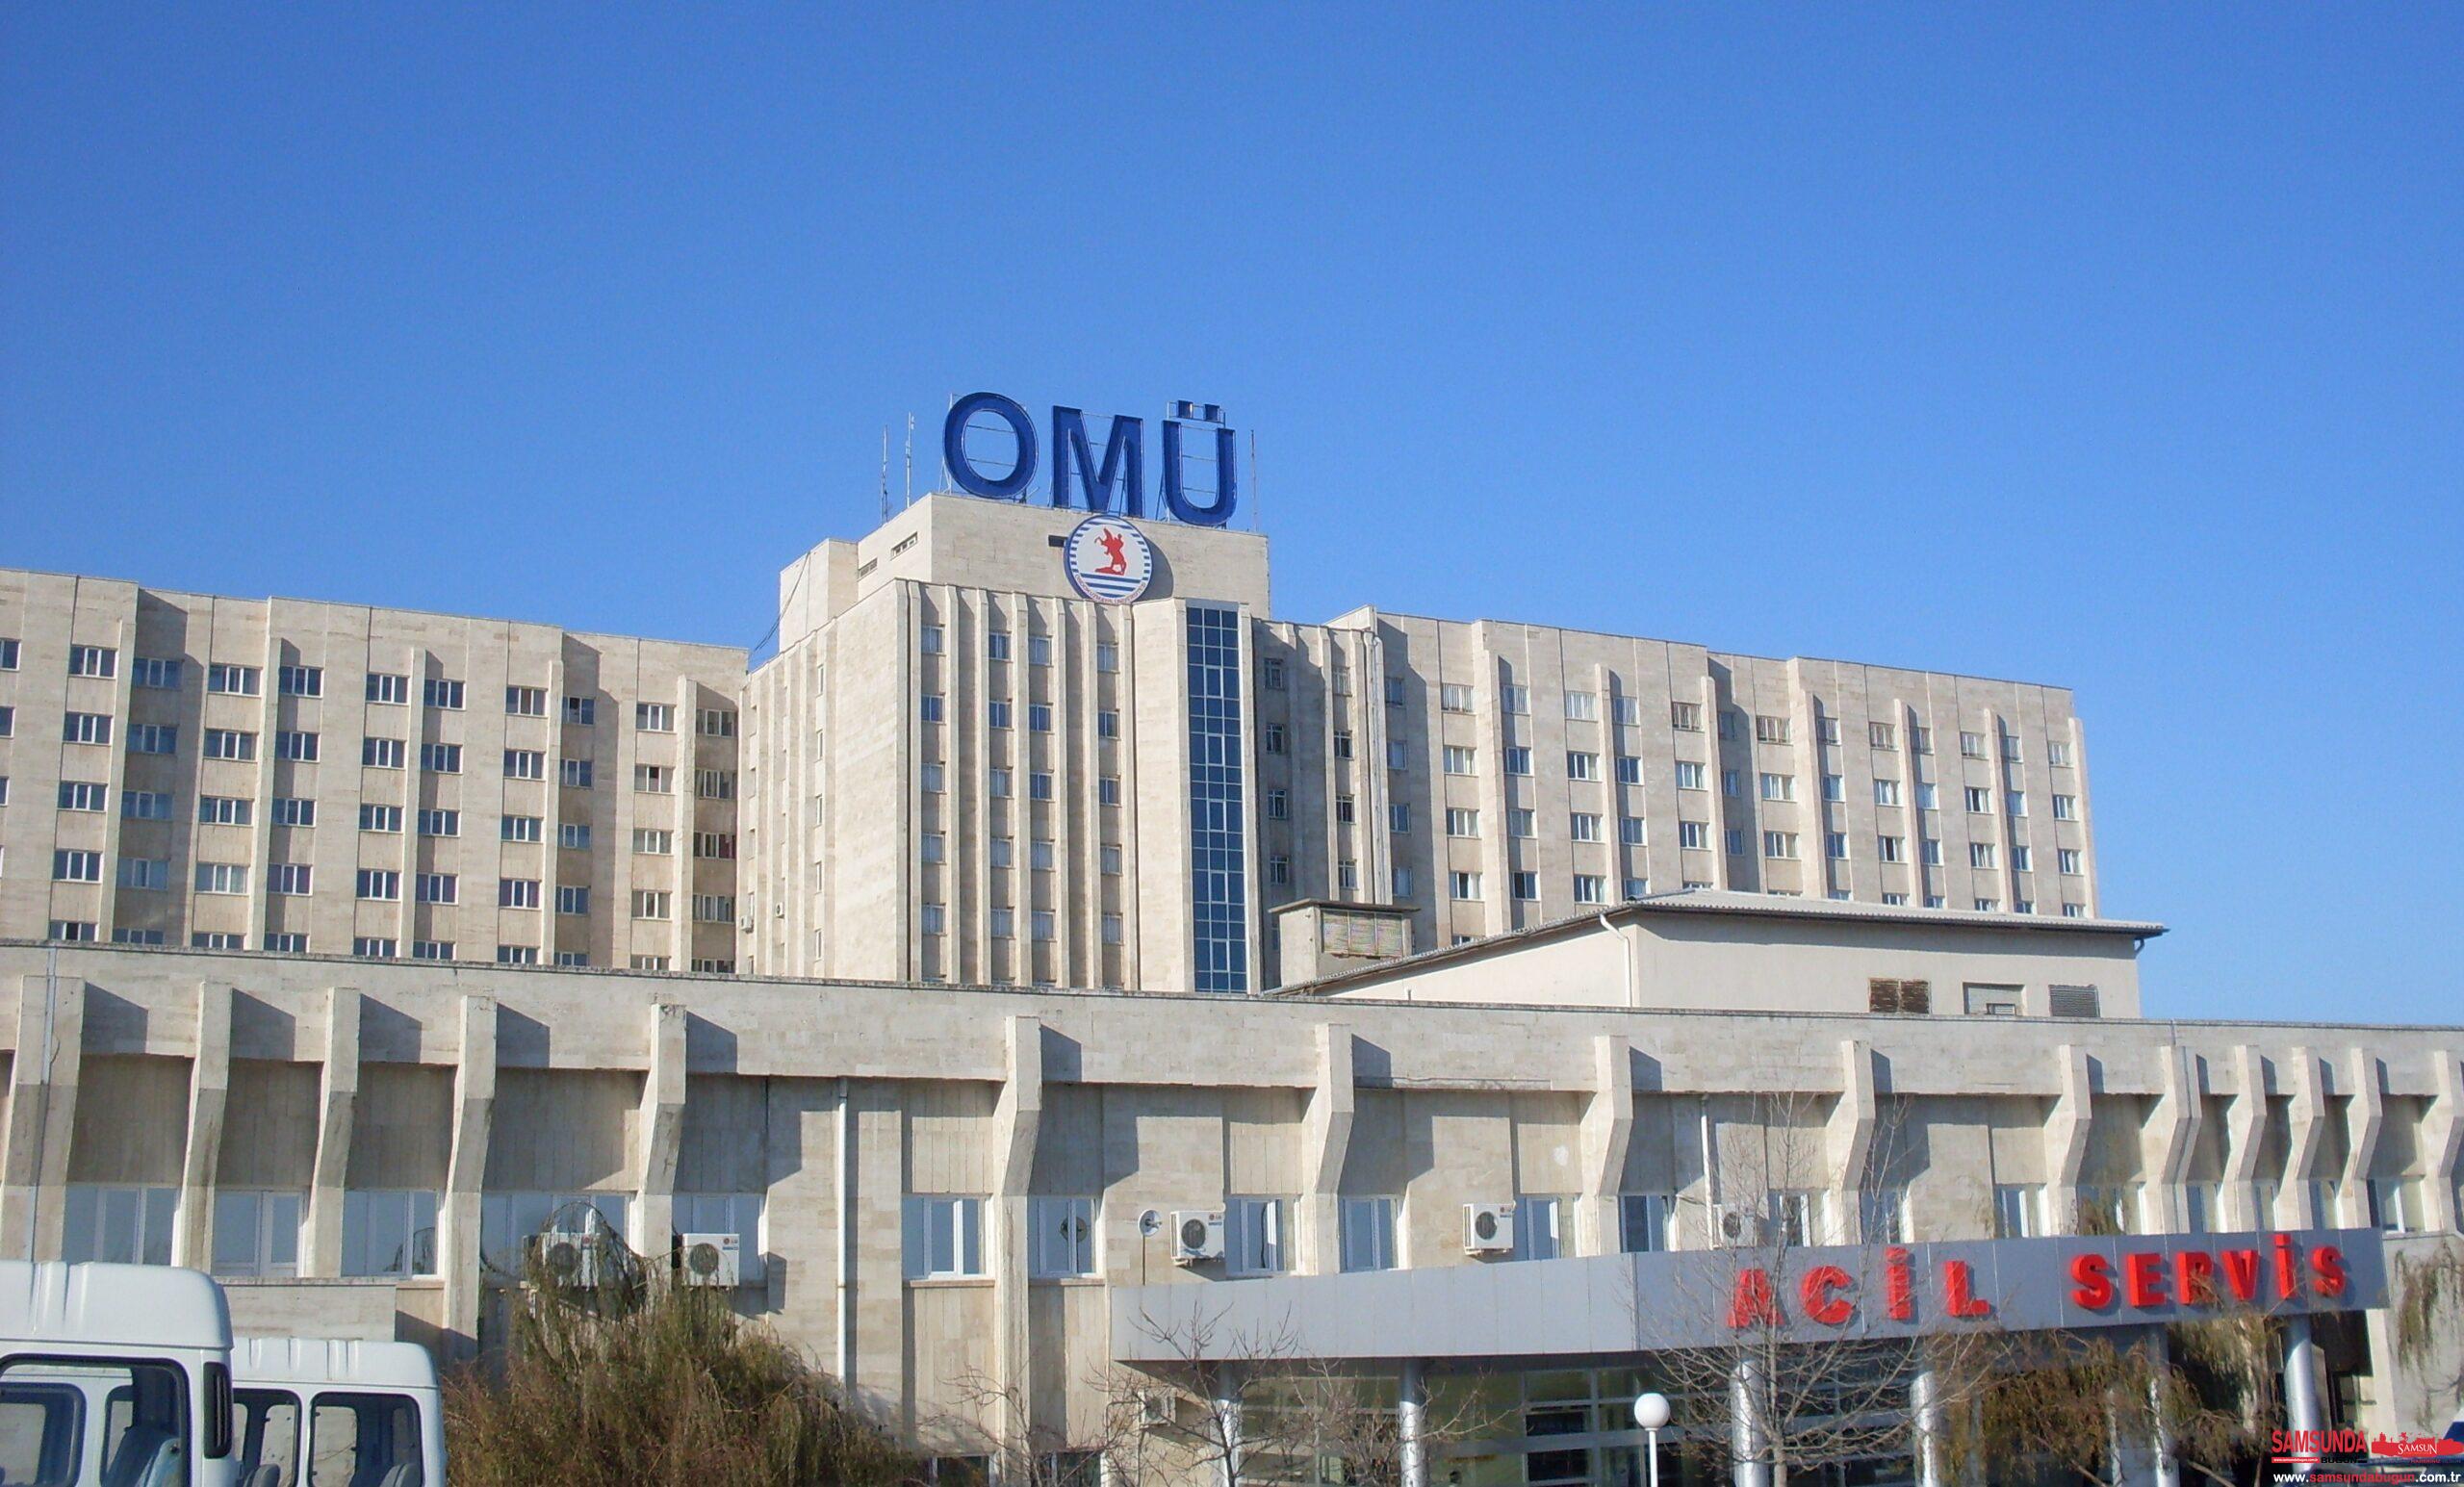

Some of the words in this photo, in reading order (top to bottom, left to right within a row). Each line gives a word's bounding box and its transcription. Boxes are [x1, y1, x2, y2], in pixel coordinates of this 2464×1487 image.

[943, 392, 1238, 526] OMÜ
[1726, 1246, 1990, 1329] ACİL
[2071, 1233, 2347, 1310] SERVİS
